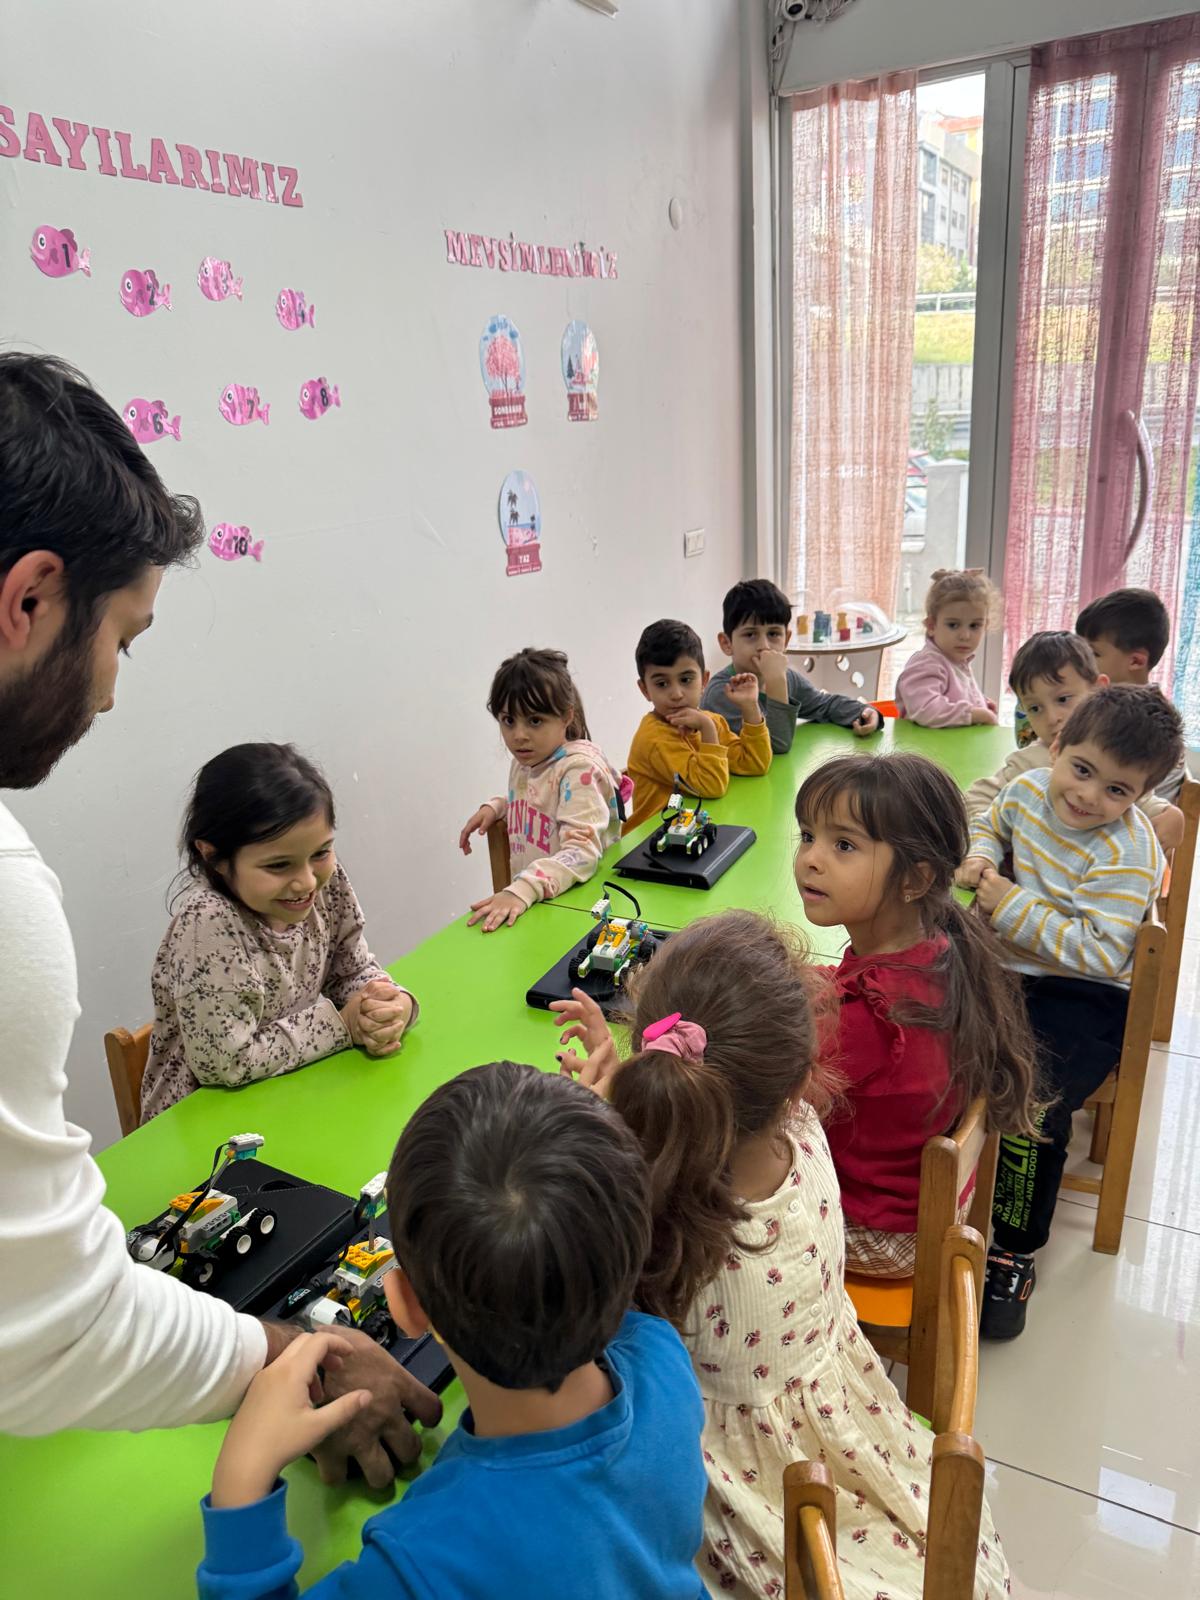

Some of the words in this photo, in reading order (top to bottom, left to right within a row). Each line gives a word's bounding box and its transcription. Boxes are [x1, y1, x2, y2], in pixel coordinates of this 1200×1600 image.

[0, 105, 304, 207] SAYILARIMIZ
[62, 243, 71, 268] 1
[146, 277, 156, 306] 2
[319, 387, 329, 407] 8
[246, 399, 255, 419] 7
[152, 412, 164, 434] 6
[232, 535, 249, 556] 10
[1028, 1149, 1038, 1178] GOOD
[1026, 1180, 1034, 1201] AND
